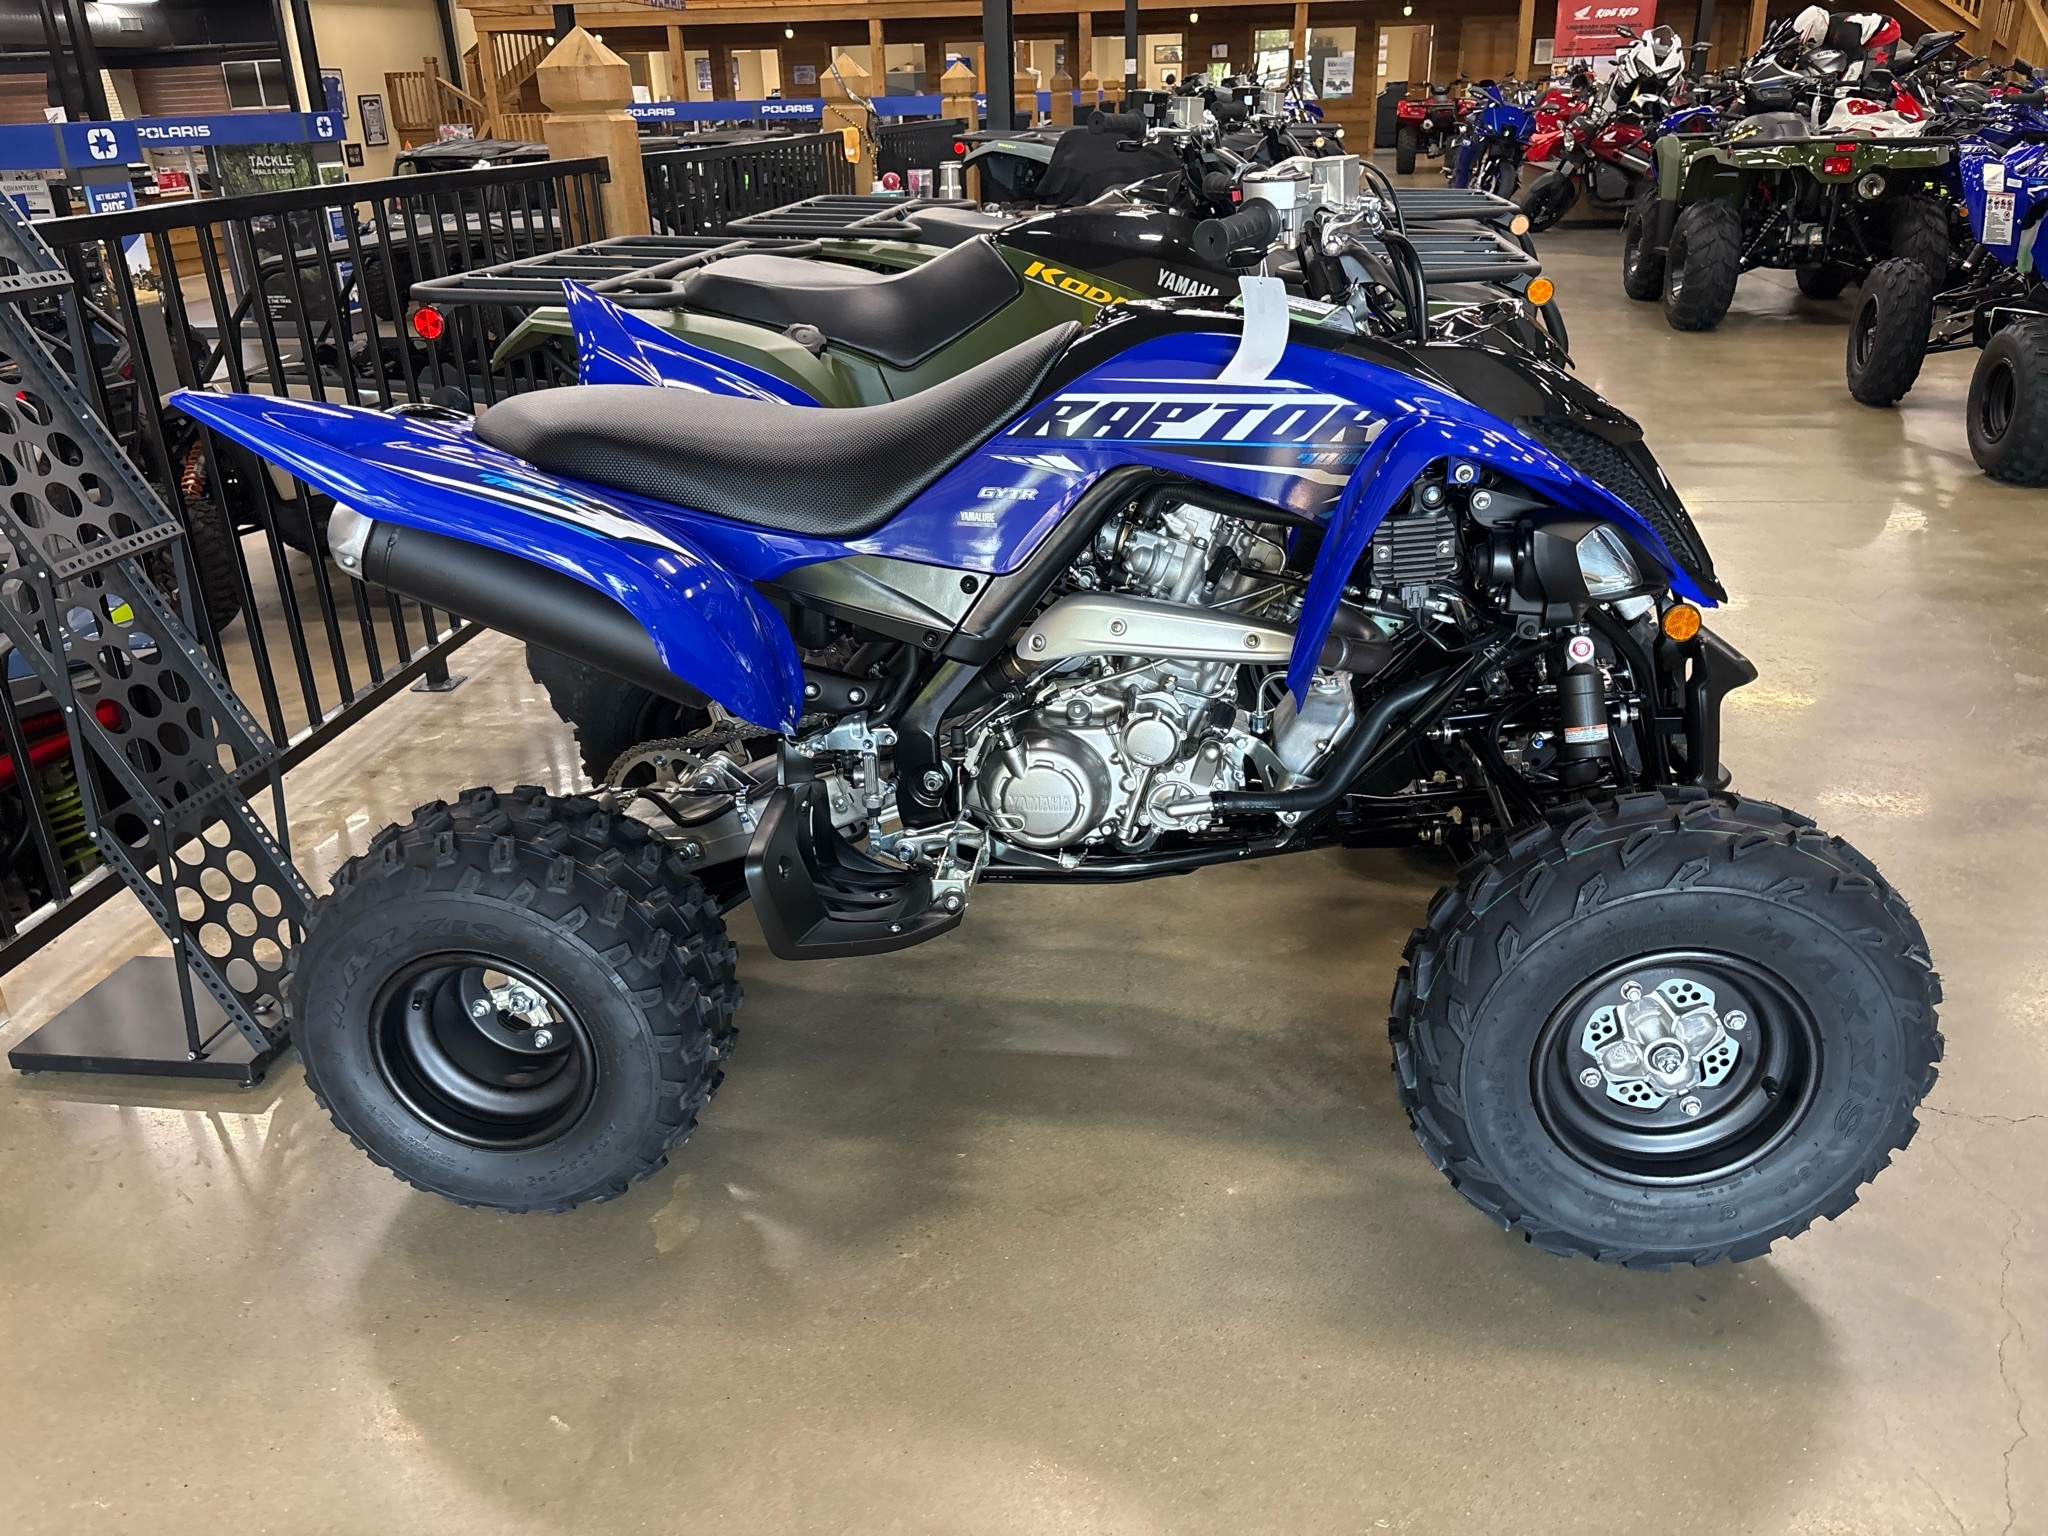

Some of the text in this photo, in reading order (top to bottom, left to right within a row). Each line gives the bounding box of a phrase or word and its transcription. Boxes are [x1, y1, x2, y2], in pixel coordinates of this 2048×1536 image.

[1594, 7, 1639, 19] RIDE RED
[625, 107, 676, 117] POLARIS
[761, 104, 815, 115] POLARIS
[137, 125, 211, 139] POLARIS
[248, 154, 295, 167] TACKLE
[95, 194, 104, 202] GET
[104, 192, 120, 200] READY
[1006, 400, 1388, 443] RAPTOR
[977, 486, 1039, 501] GYTR
[960, 511, 996, 523] YAMALUBE
[1009, 794, 1073, 811] YAMAHA
[1744, 922, 1877, 1140] MAXXIS
